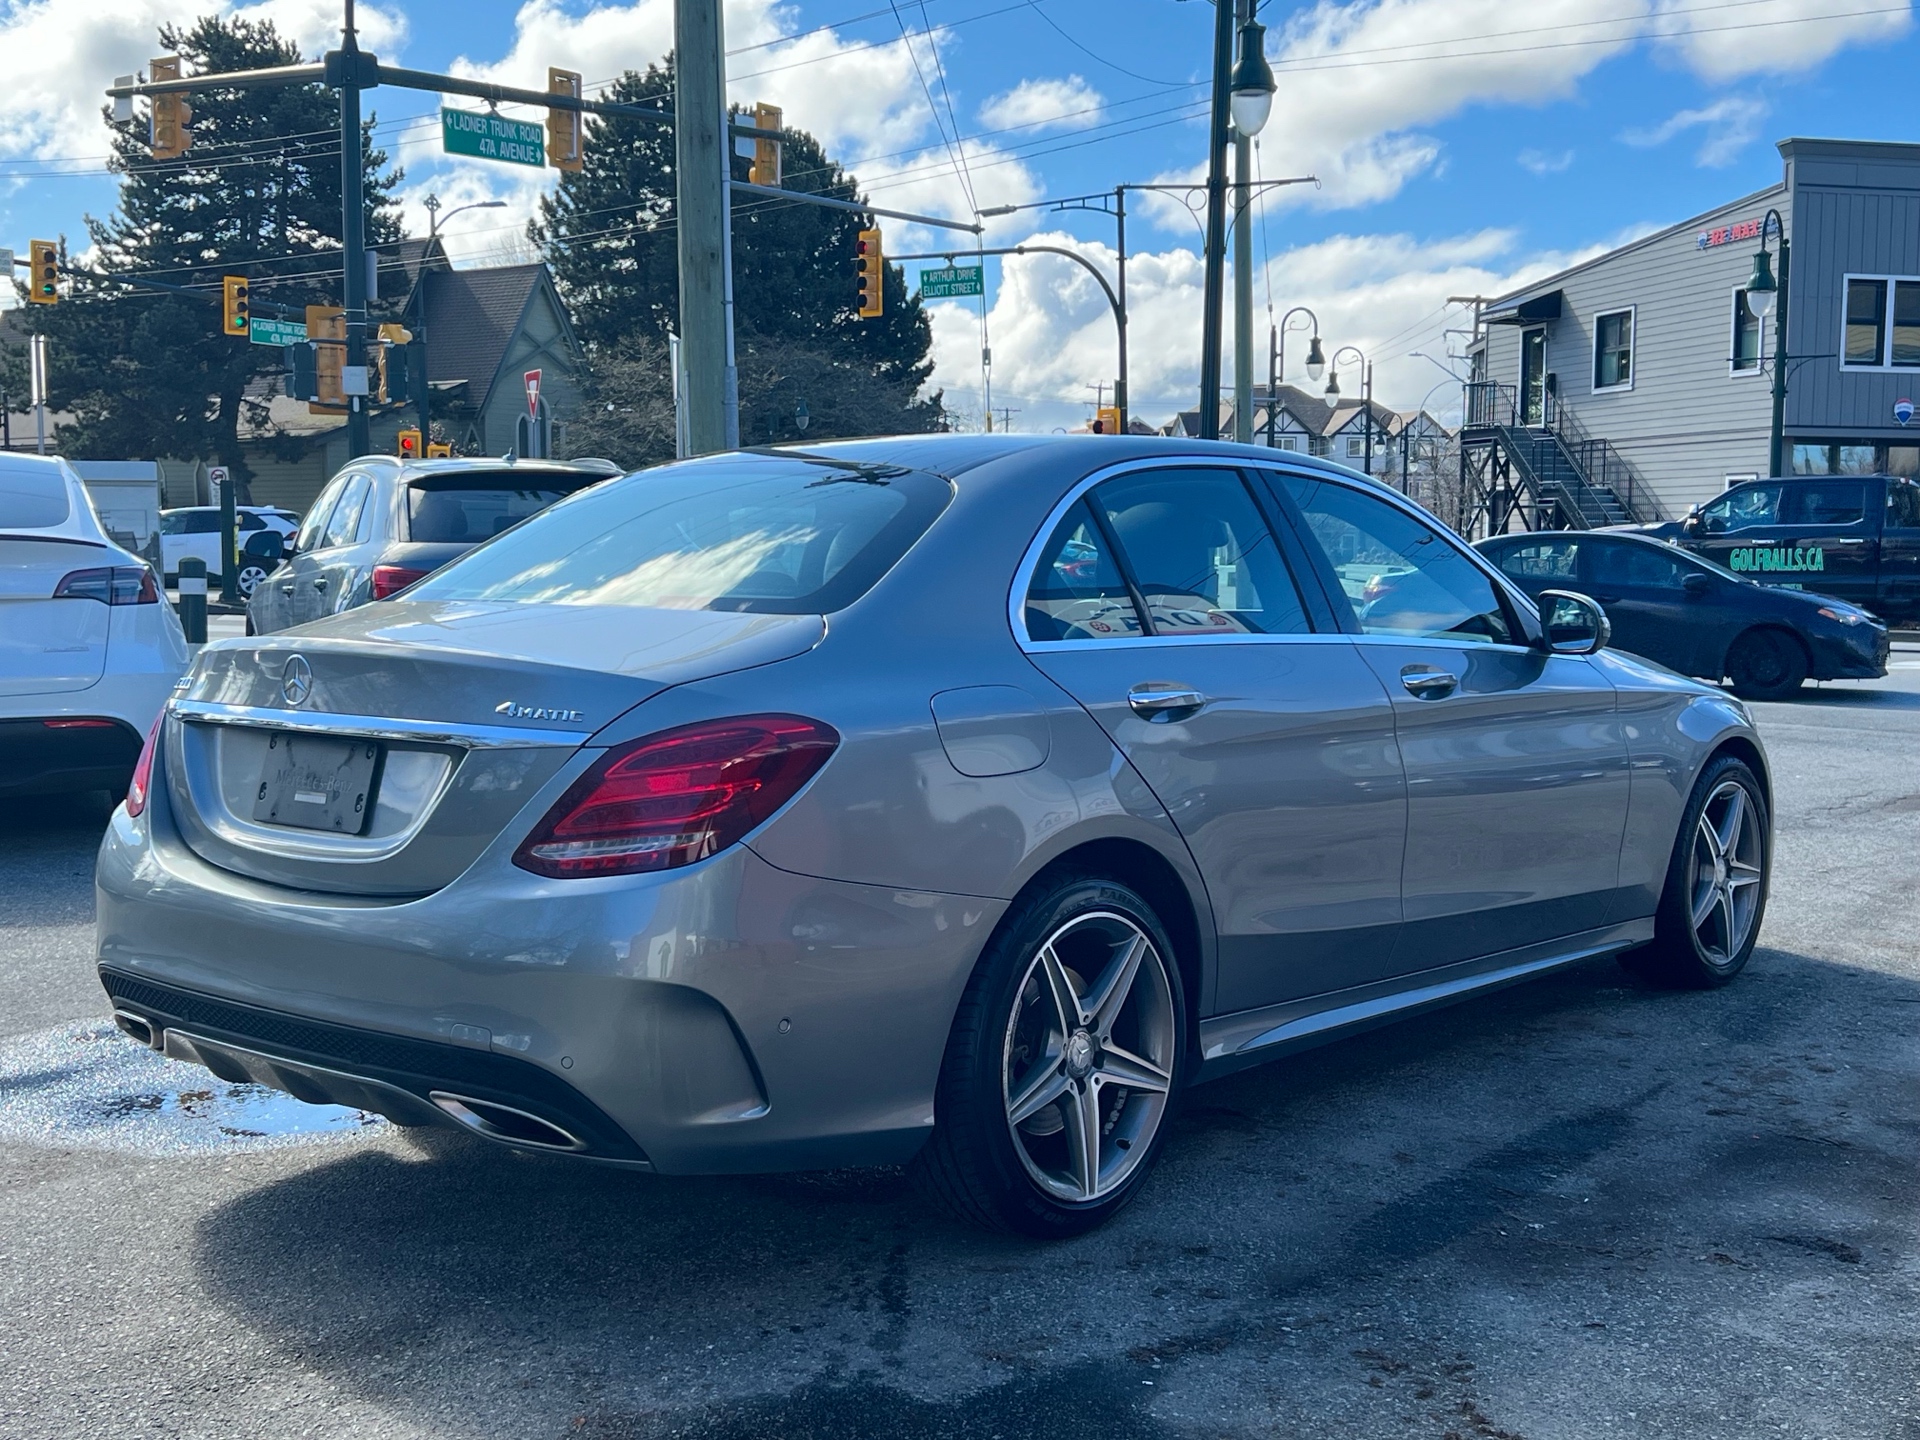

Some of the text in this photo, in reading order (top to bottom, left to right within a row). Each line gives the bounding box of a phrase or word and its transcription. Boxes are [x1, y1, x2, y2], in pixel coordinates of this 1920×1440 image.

[453, 113, 542, 144] LADNER TRUNK ROAD
[479, 138, 535, 162] 47A AVENUE
[929, 268, 977, 283] ARTHUR DRIVE
[923, 282, 975, 297] ELLIOTT STREET
[1730, 547, 1824, 571] GOLFBALLS.CA
[495, 701, 584, 722] 4MATIC
